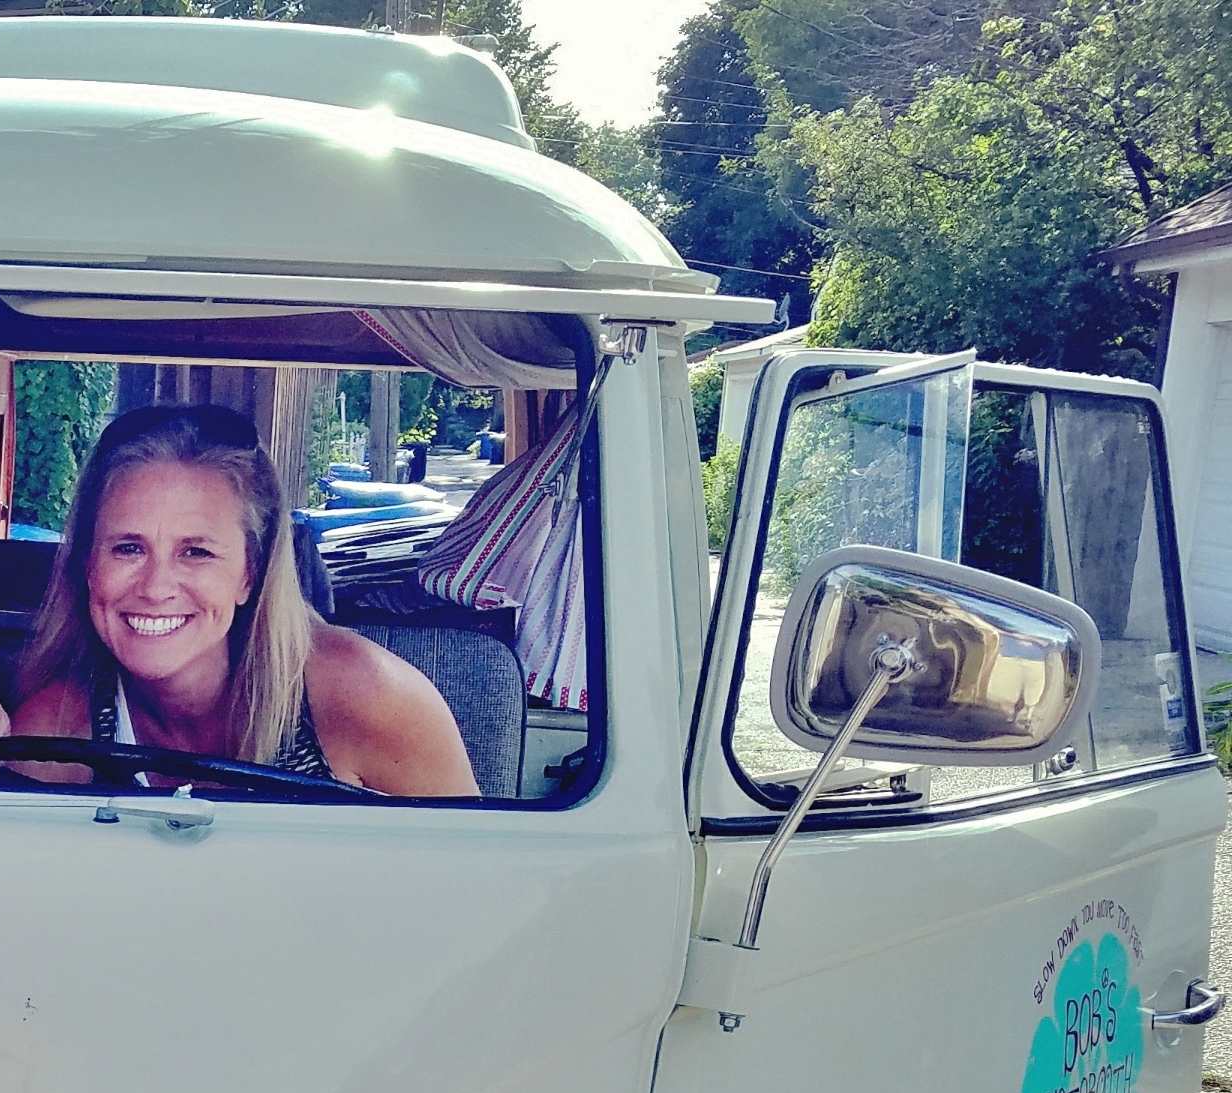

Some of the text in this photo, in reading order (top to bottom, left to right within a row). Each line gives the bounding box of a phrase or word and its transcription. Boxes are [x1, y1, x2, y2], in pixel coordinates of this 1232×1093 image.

[1033, 950, 1056, 1005] SLOW
[1057, 915, 1080, 960] DOWN
[1081, 901, 1095, 925] YOU
